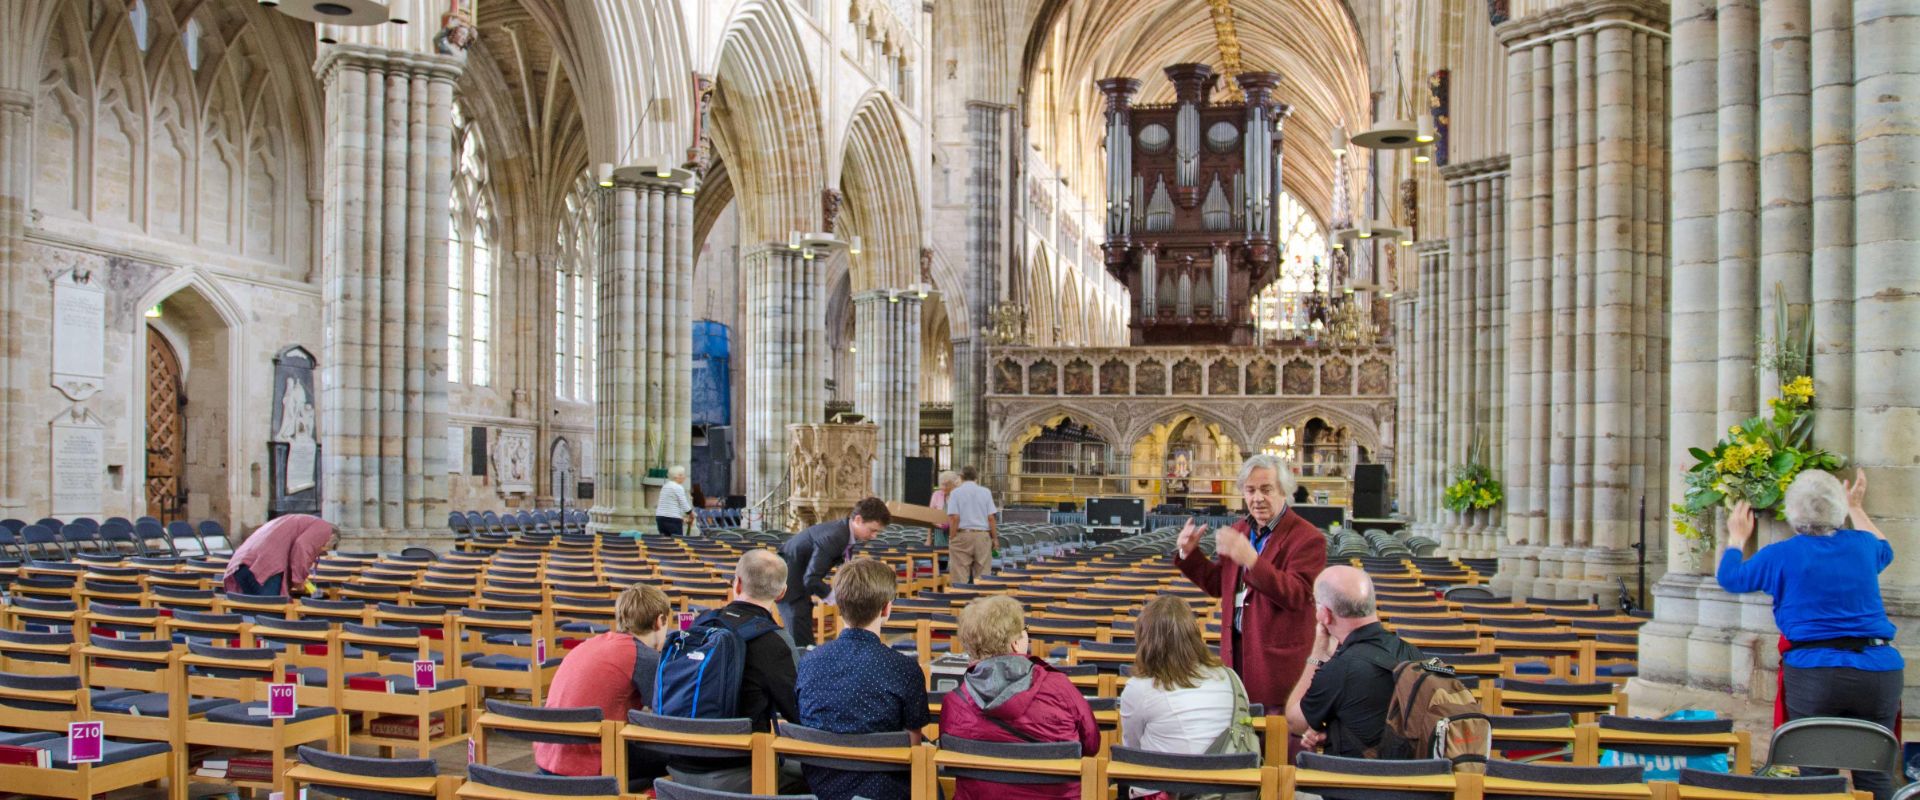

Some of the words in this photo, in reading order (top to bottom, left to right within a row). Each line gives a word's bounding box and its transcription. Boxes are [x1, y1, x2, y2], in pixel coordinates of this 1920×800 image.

[416, 664, 433, 673] X10
[272, 687, 292, 698] Y10
[73, 727, 99, 739] Z10
